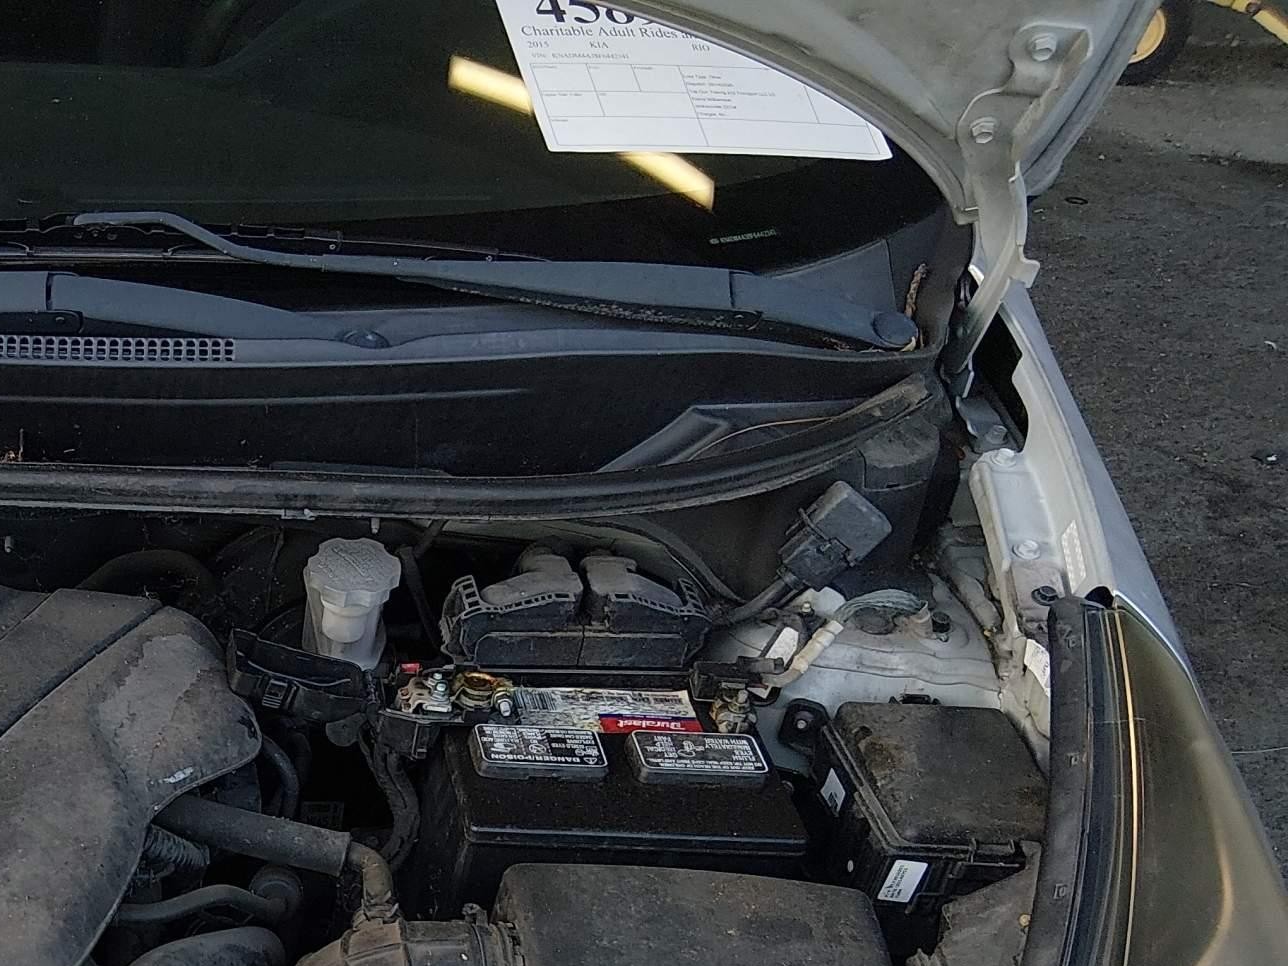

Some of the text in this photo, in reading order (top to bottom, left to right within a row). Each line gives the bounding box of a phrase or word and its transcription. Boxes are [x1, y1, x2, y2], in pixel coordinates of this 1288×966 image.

[521, 25, 593, 37] Charitable
[598, 27, 635, 38] Adult
[639, 27, 678, 39] Rides
[527, 41, 550, 49] 2015
[691, 43, 710, 52] RIO
[617, 719, 686, 730] Duralast
[491, 753, 581, 763] DANGER/POISON
